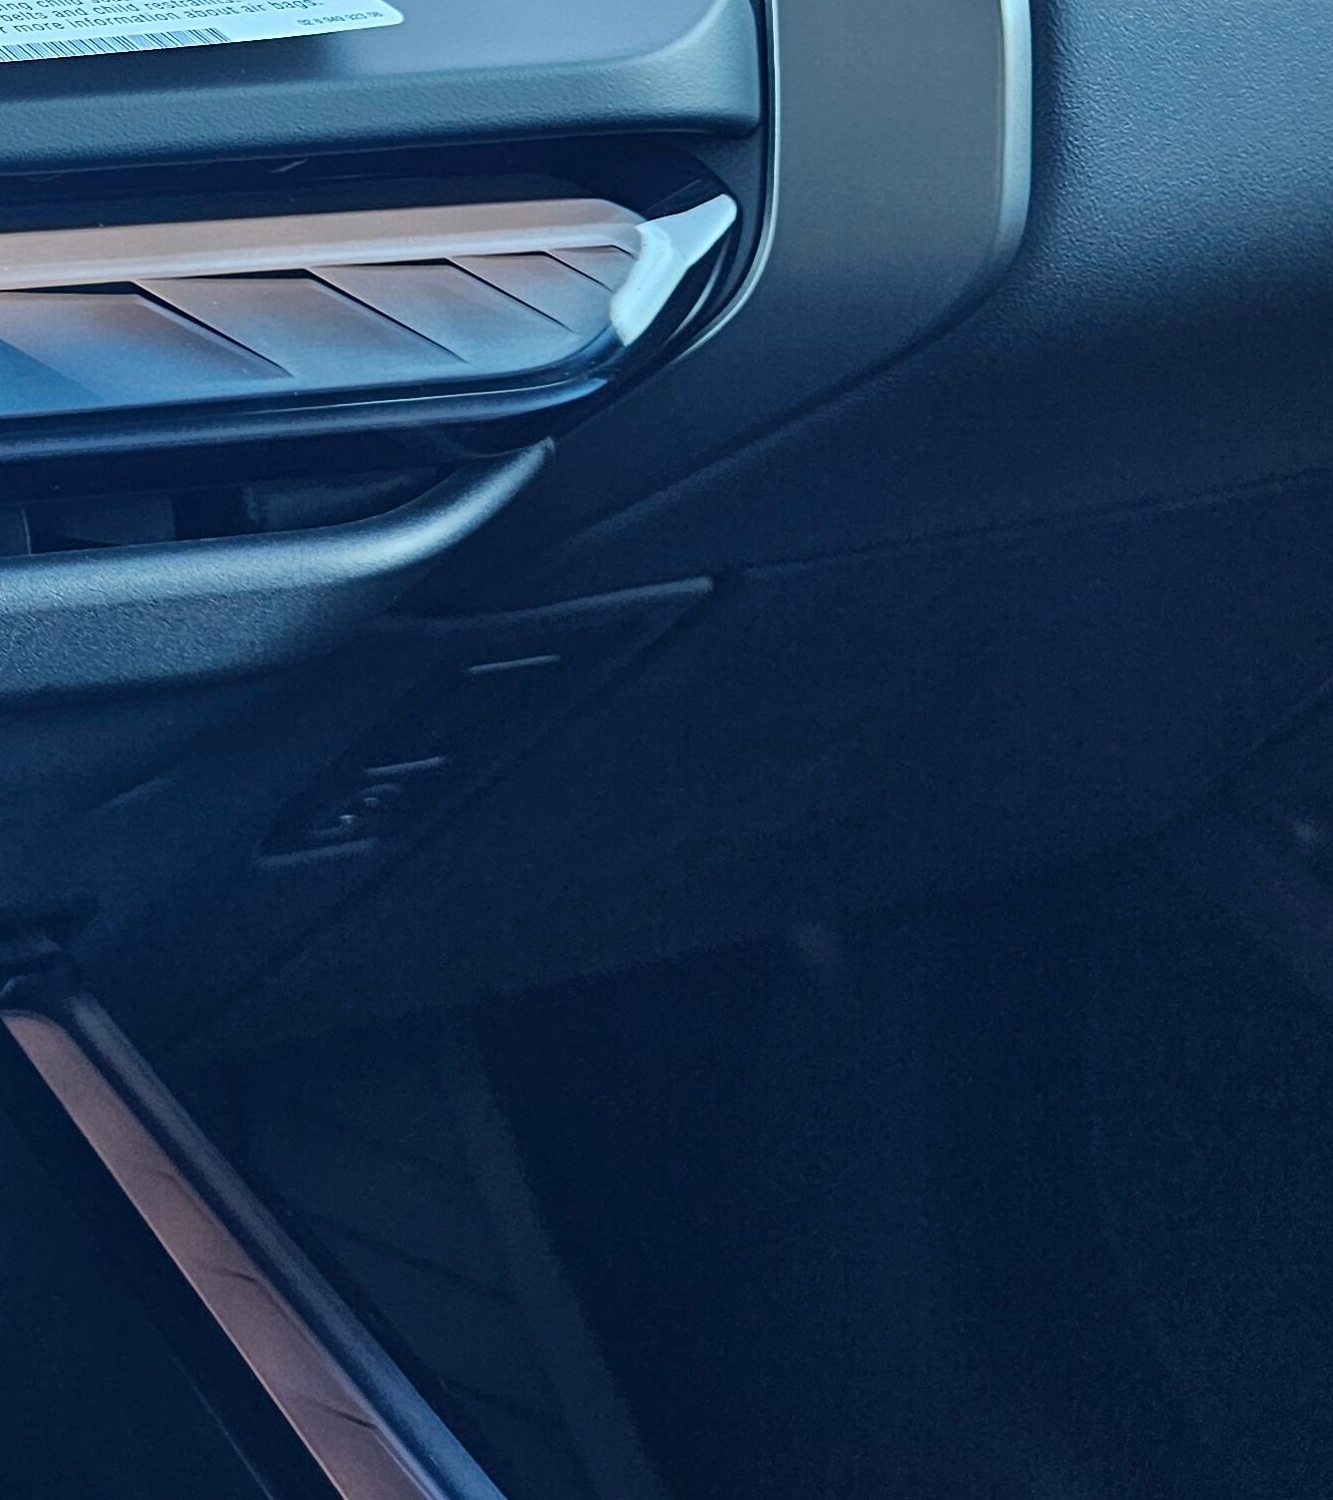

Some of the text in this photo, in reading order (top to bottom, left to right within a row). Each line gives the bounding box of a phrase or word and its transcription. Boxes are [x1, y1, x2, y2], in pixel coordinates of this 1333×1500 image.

[13, 21, 66, 33] more
[66, 11, 182, 29] information
[183, 6, 240, 20] about
[241, 2, 269, 14] air
[51, 6, 89, 18] and
[92, 3, 140, 15] child
